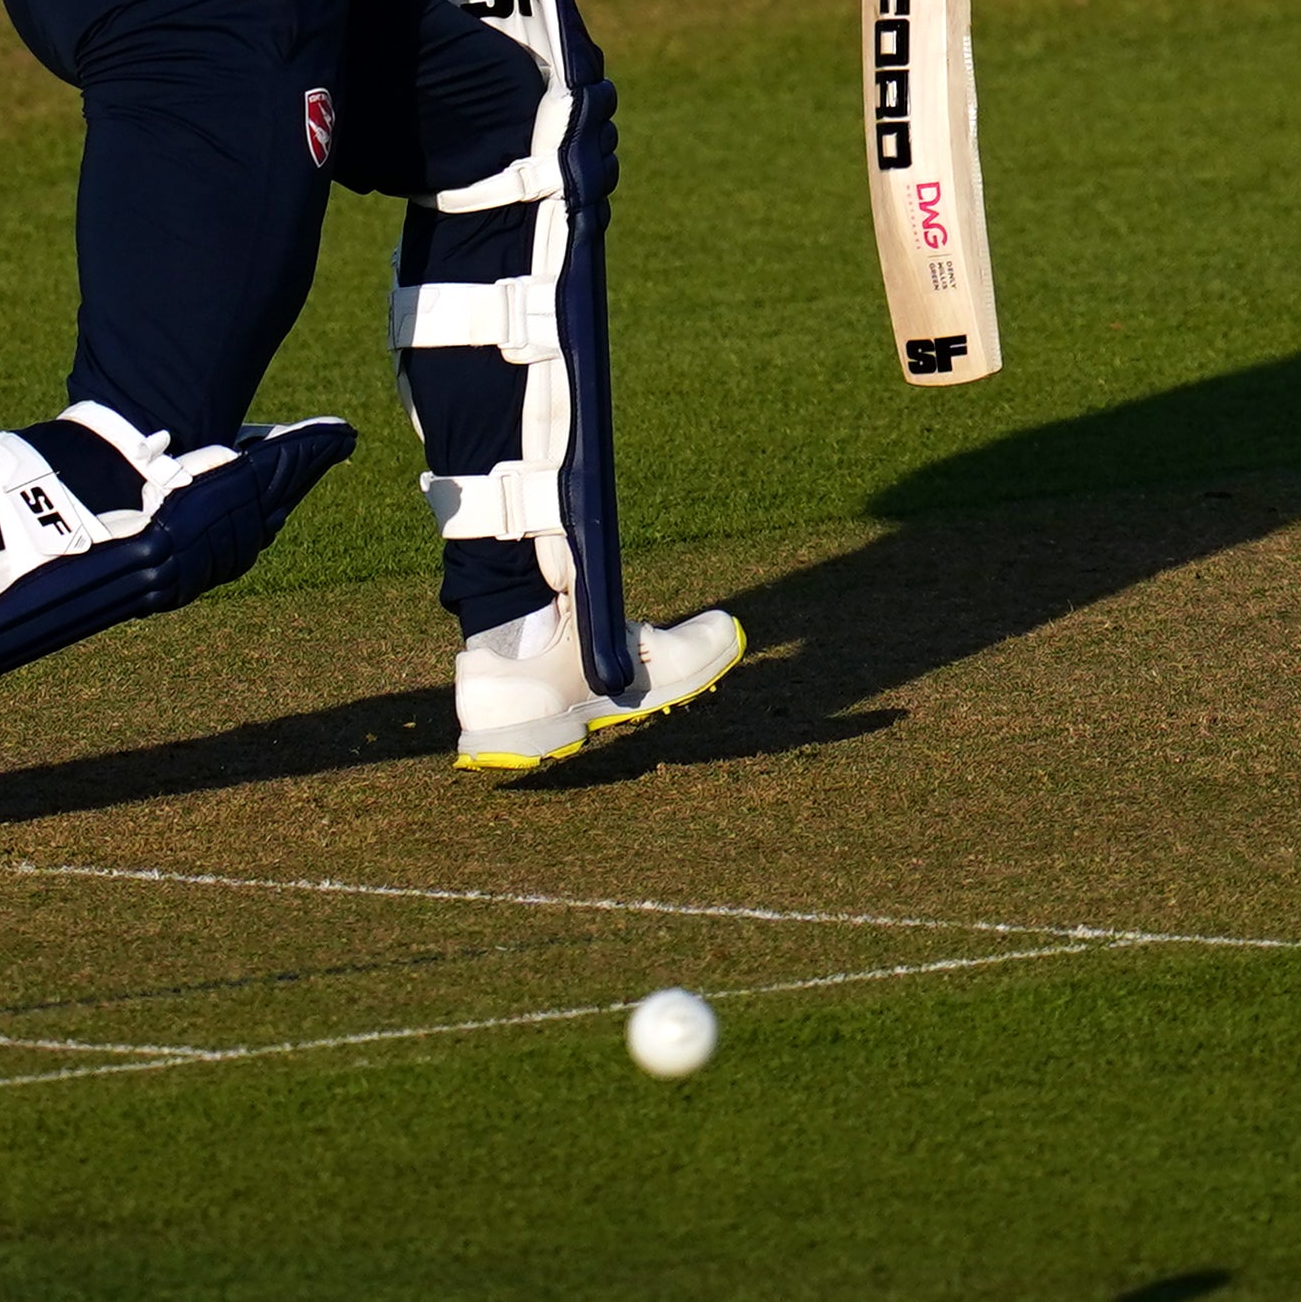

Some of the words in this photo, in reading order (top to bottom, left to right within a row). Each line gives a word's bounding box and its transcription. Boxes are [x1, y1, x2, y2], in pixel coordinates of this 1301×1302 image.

[916, 182, 948, 249] DWG
[928, 263, 940, 291] GREEN
[905, 334, 968, 375] SF
[20, 486, 73, 538] SF
